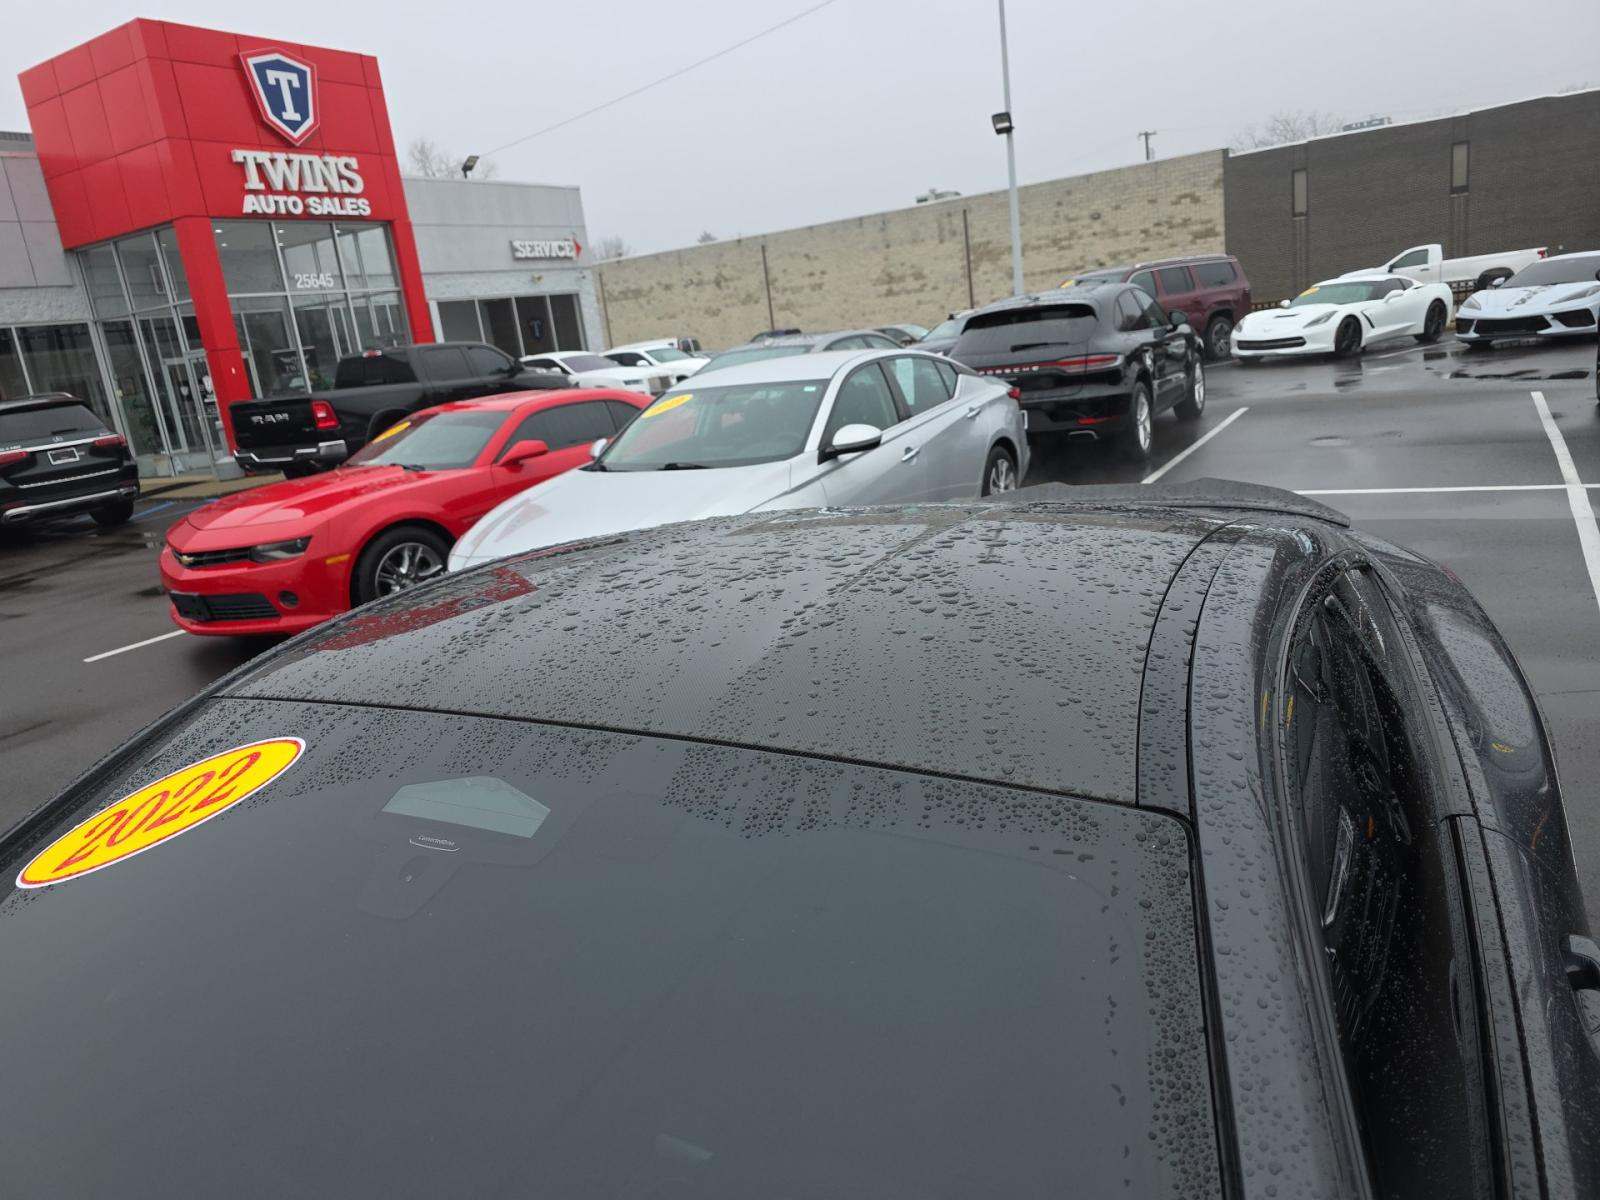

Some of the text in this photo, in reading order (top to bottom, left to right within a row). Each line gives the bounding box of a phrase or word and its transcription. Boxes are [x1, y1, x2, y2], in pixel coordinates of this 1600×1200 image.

[265, 69, 301, 121] T
[231, 149, 364, 194] TWINS
[242, 194, 371, 216] AUTO SALES
[512, 239, 574, 258] SERVICE
[294, 272, 335, 289] 25645
[251, 412, 290, 425] RAM
[51, 752, 261, 873] 2022
